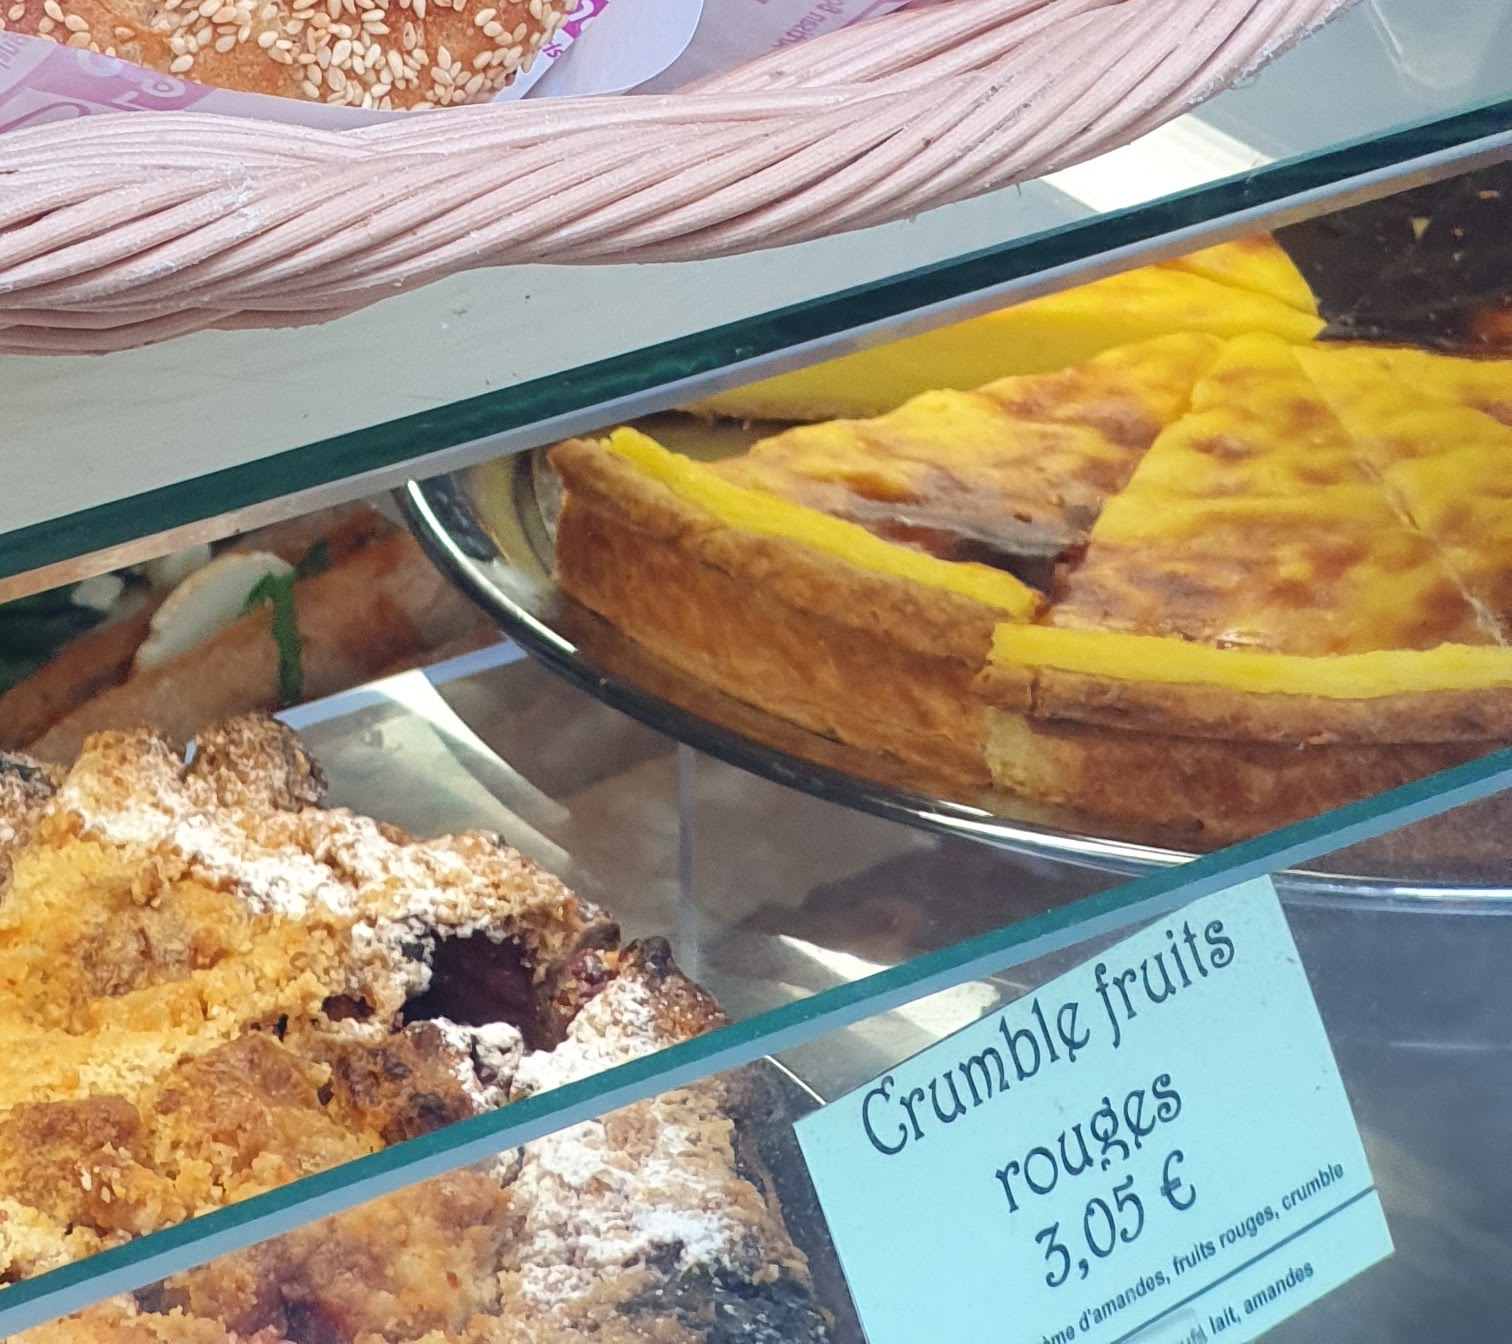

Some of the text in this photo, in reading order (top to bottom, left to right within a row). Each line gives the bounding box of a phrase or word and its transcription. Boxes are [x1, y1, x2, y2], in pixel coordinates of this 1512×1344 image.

[861, 918, 1236, 1156] Crumble fruits
[995, 1072, 1182, 1213] rouges
[1034, 1149, 1197, 1288] 3,05 €
[1079, 1271, 1171, 1333] d'amandes,
[1172, 1239, 1216, 1276] fruits
[1219, 1208, 1280, 1250] rouges,
[1281, 1162, 1344, 1211] crumble
[1209, 1305, 1242, 1335] lait,
[1243, 1261, 1314, 1315] amandes
